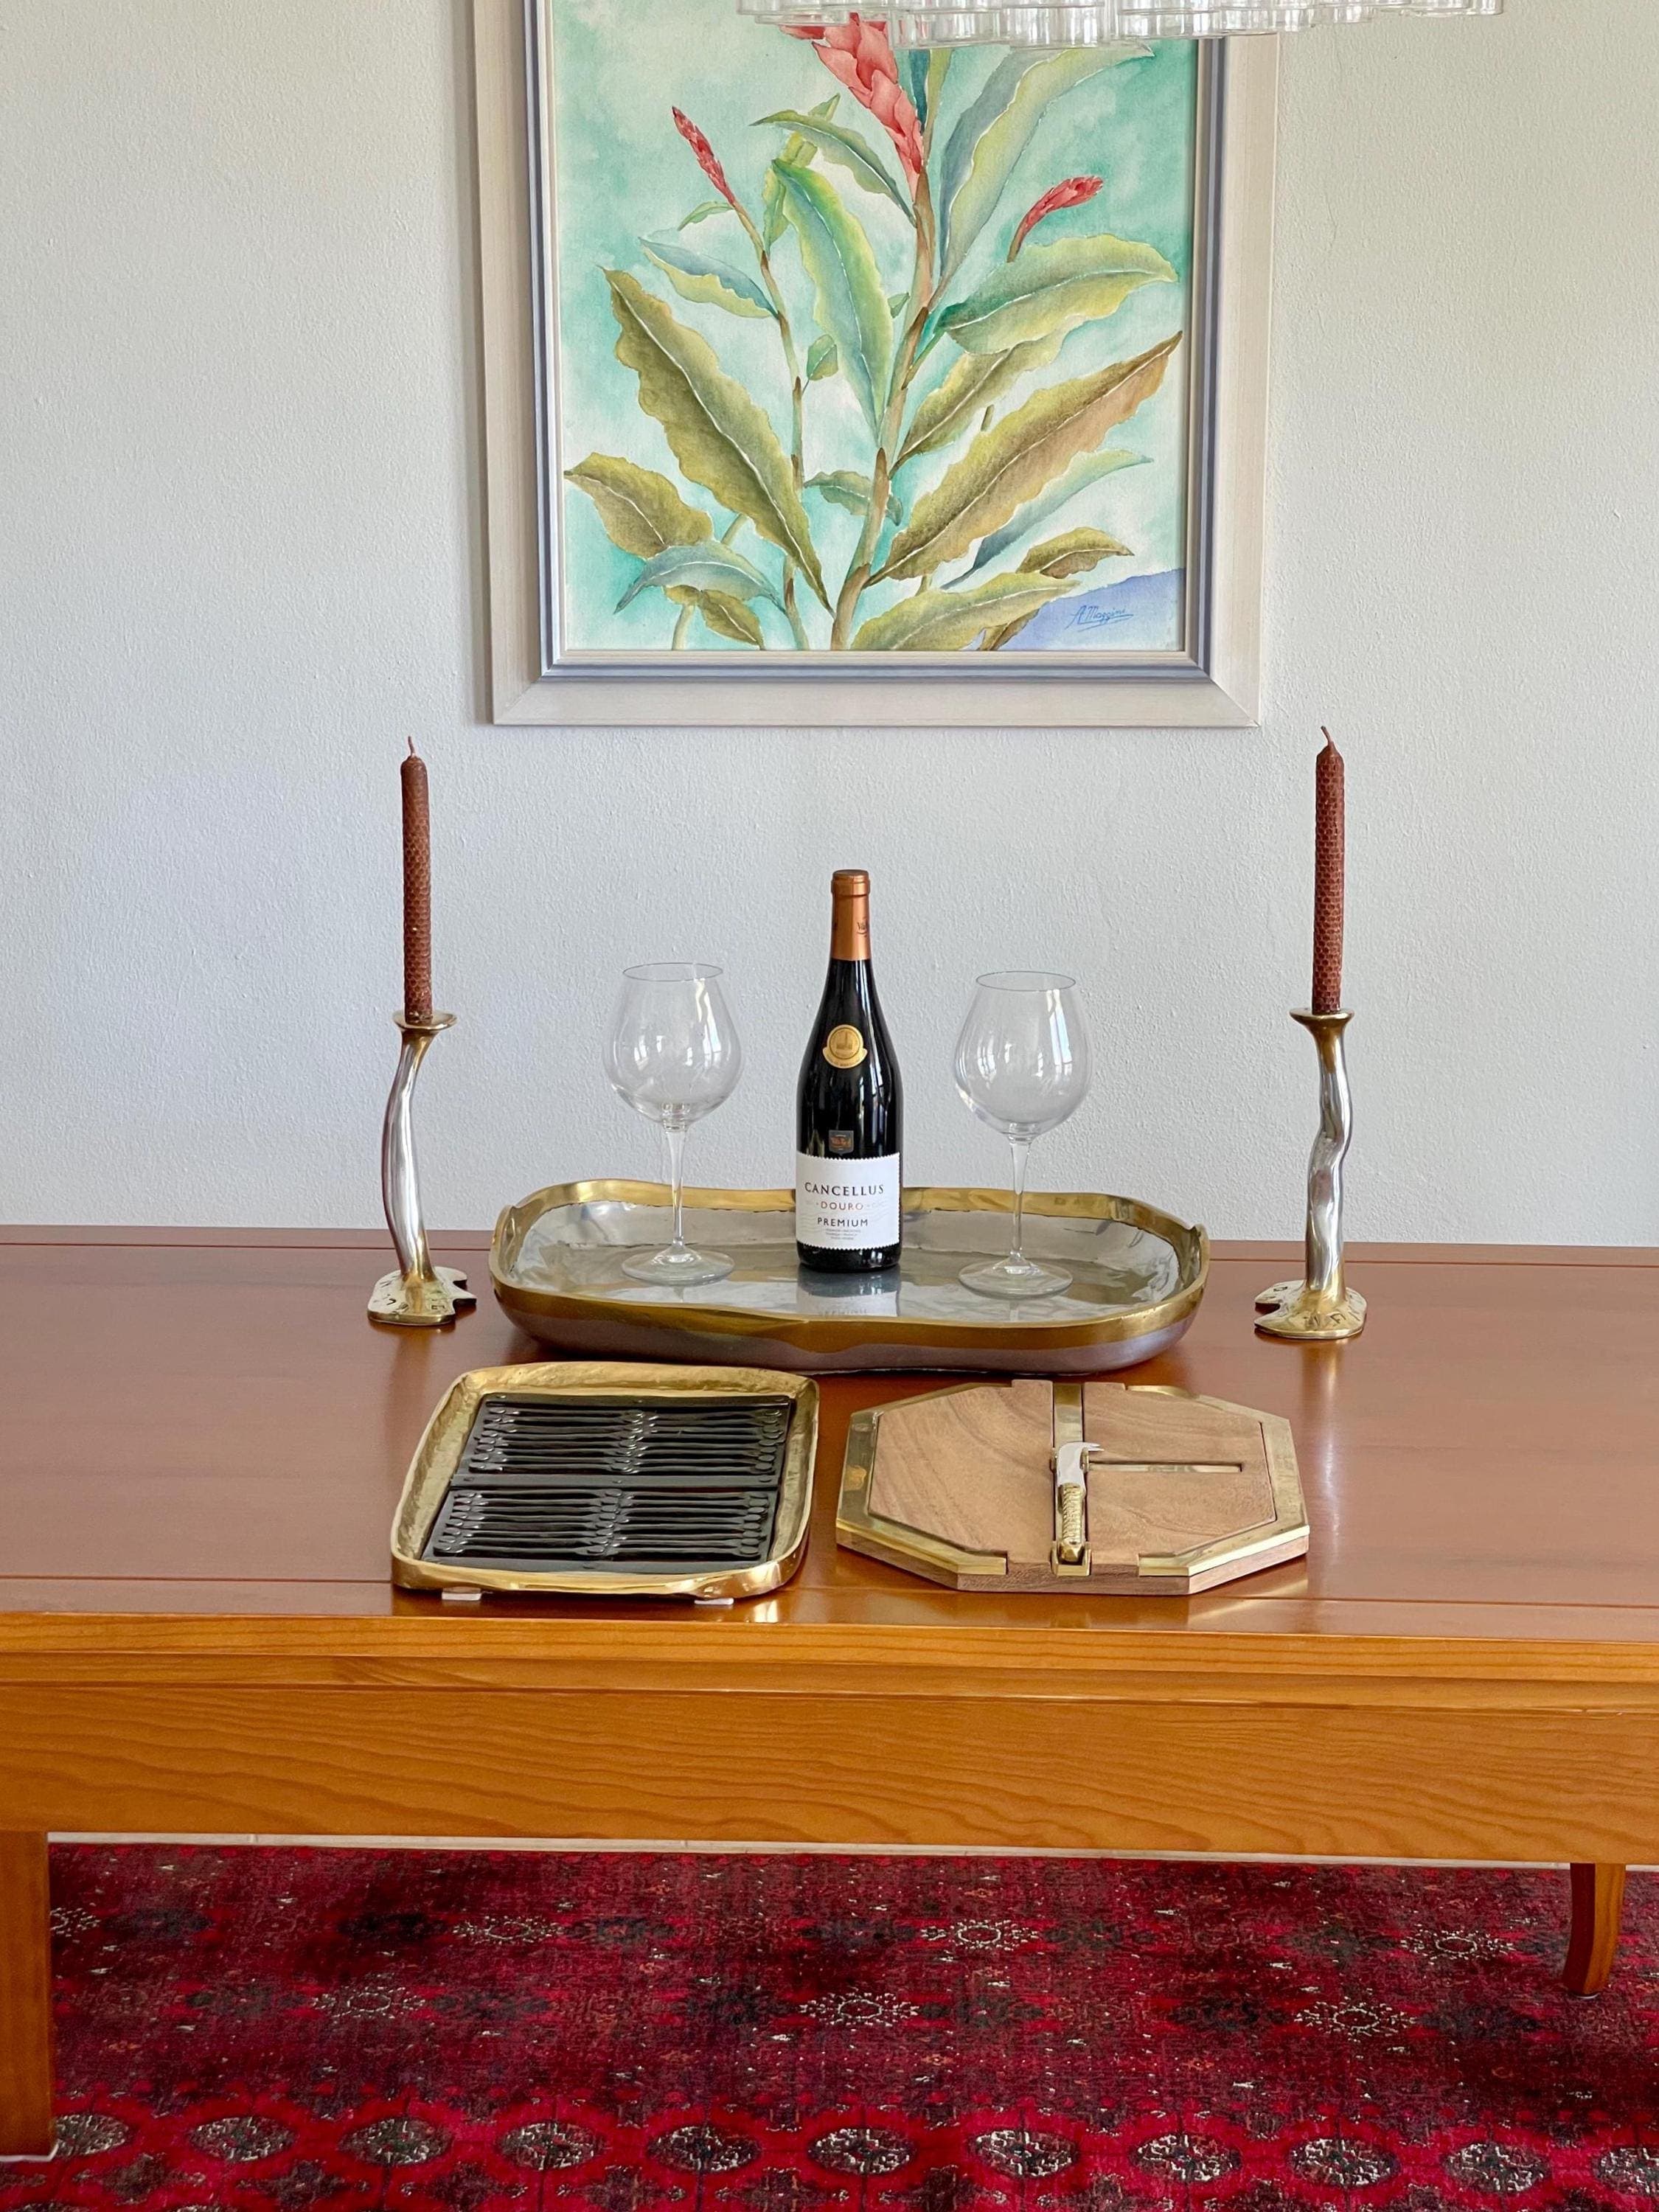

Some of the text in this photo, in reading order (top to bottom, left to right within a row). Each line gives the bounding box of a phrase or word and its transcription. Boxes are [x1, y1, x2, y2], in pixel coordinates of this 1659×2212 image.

[804, 1182, 884, 1196] CANCELLUS
[821, 1200, 863, 1210] DOURO
[817, 1217, 868, 1227] PREMIUM
